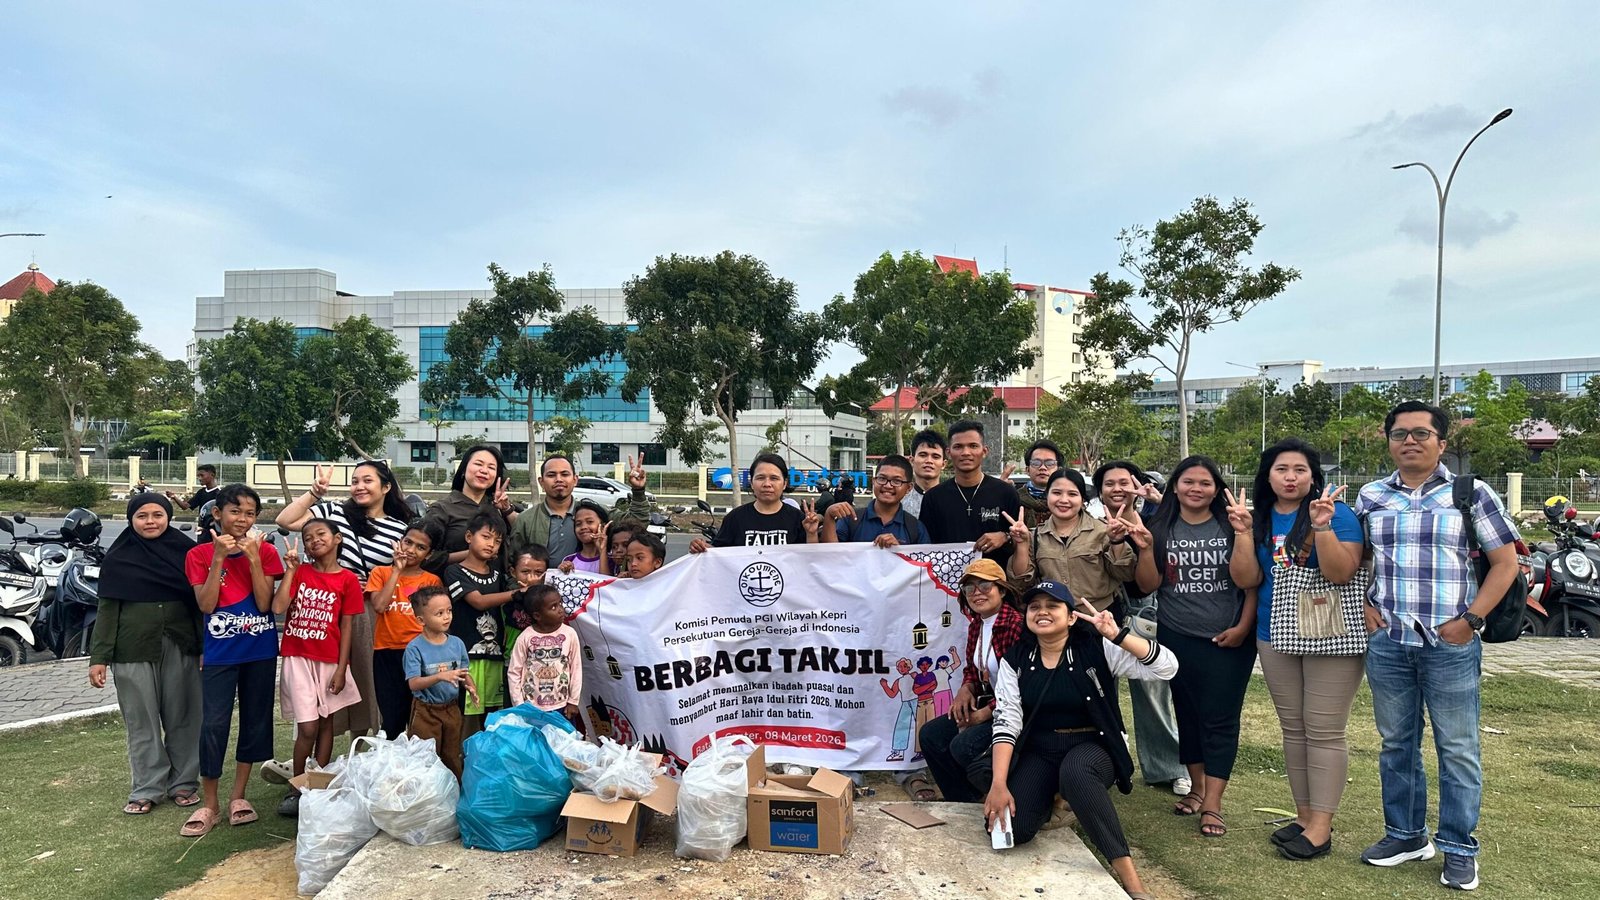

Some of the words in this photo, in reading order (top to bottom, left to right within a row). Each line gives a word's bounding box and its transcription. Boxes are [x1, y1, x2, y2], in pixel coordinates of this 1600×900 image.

[745, 533, 788, 546] FAITH
[1171, 539, 1206, 549] DON'T
[1208, 538, 1227, 547] GET
[1167, 550, 1230, 566] DRUNK
[1178, 568, 1183, 581] I
[1188, 567, 1218, 581] GET
[1173, 580, 1229, 593] AWESOME
[297, 582, 338, 608] Jesus
[299, 607, 334, 623] REASON
[675, 616, 709, 631] Komisi
[711, 615, 752, 625] Pemuda
[755, 614, 773, 623] PGI
[776, 611, 818, 622] Wilayah
[820, 610, 847, 621] Kepri
[285, 620, 328, 640] Season
[663, 630, 726, 647] Persekutuan
[728, 625, 798, 637] Gereja-Gereja
[800, 623, 809, 632] di
[812, 623, 860, 634] Indonesia
[633, 647, 772, 692] BERBAGI
[778, 646, 890, 675] TAKJIL
[678, 689, 710, 709] Selamat
[712, 681, 769, 696] menunaikan
[772, 681, 803, 690] ibadah
[837, 684, 854, 695] dan
[669, 701, 718, 726] menyambut
[719, 696, 739, 708] Hari
[741, 695, 764, 705] Raya
[766, 694, 785, 704] Idul
[787, 695, 808, 704] Fitri
[835, 699, 865, 709] Mohon
[715, 710, 739, 723] maaf
[741, 708, 764, 718] lahir
[767, 708, 784, 718] dan
[787, 709, 814, 719] batin.
[764, 730, 779, 740] 08
[781, 731, 812, 742] Maret
[815, 733, 841, 745] 2026
[771, 807, 815, 817] sanford
[776, 831, 811, 842] water
